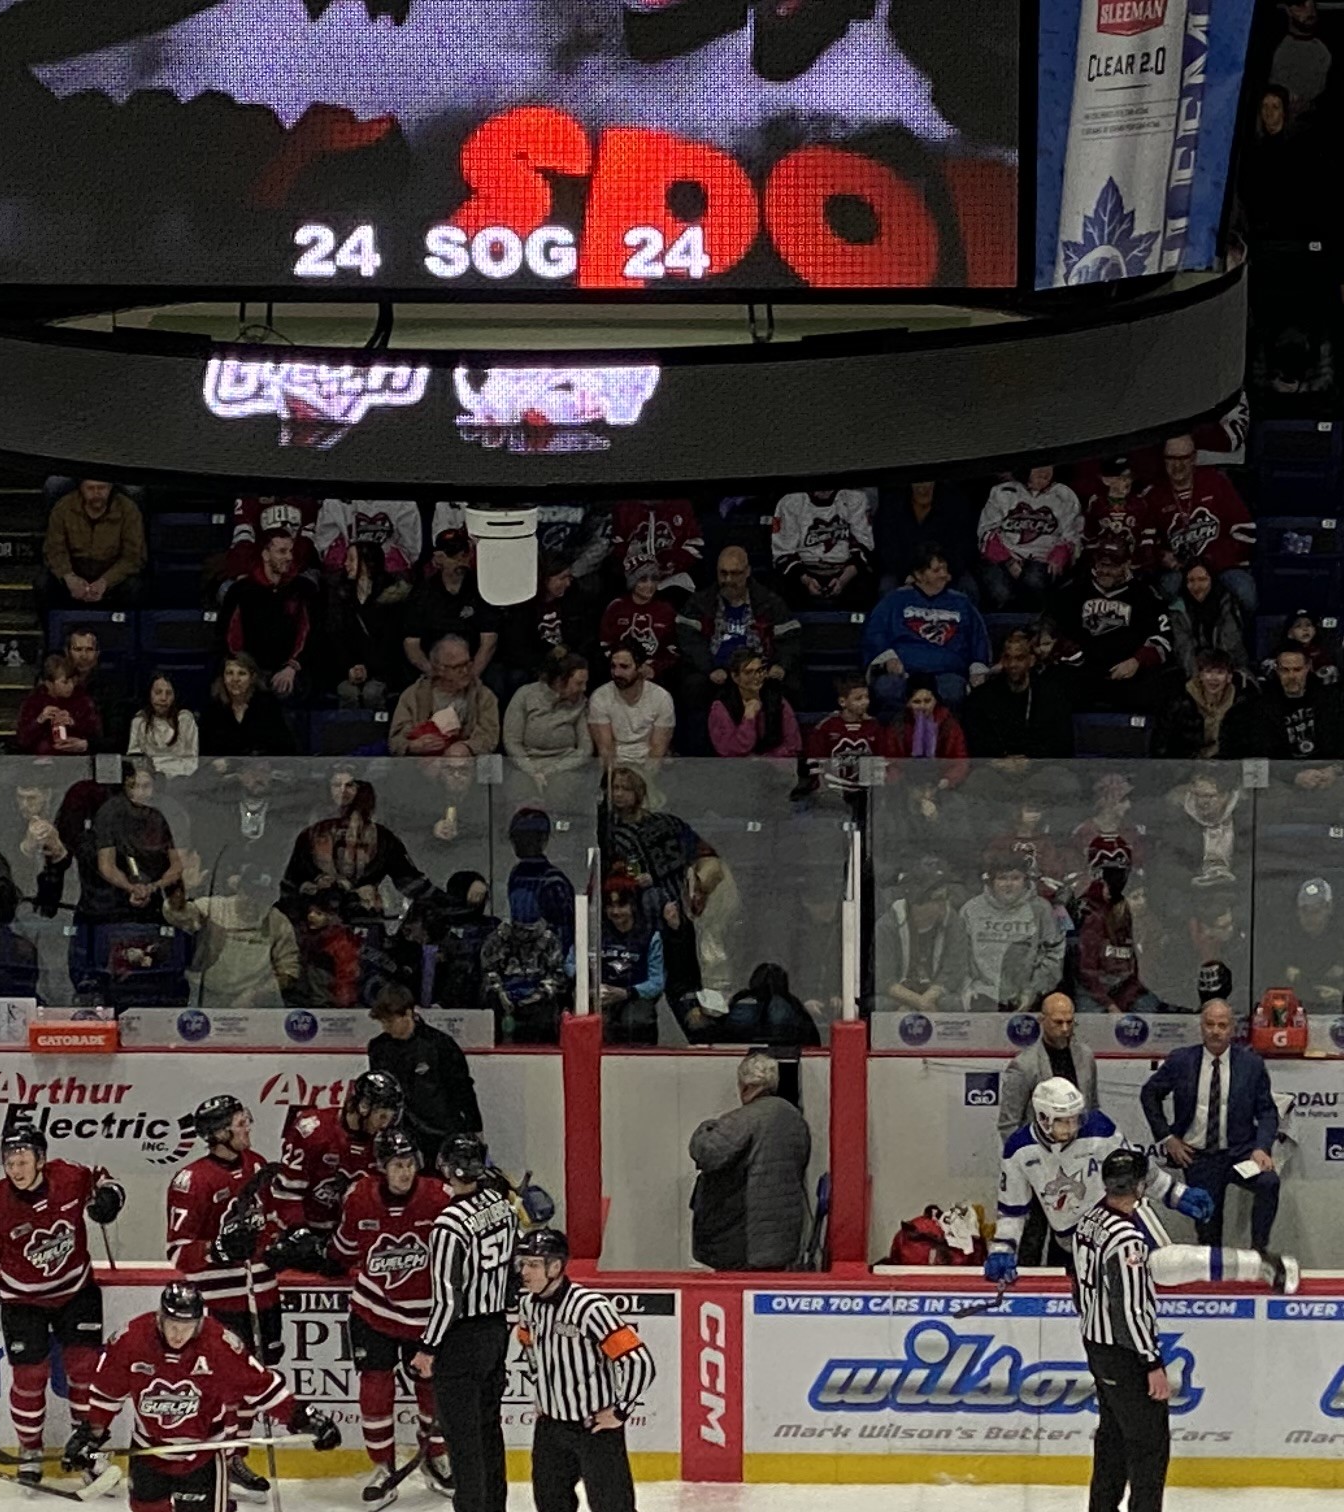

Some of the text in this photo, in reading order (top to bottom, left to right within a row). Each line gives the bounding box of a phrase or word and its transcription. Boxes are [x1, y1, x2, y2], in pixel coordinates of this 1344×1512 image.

[1087, 47, 1166, 81] CLEAR 2.0
[293, 224, 712, 279] 24 SOG 24
[37, 1034, 106, 1047] GATORADE
[1272, 1031, 1288, 1047] G
[1, 1102, 172, 1139] Electric
[141, 1142, 170, 1153] INC.
[282, 1143, 305, 1171] 22
[480, 1228, 509, 1270] 57
[369, 1252, 428, 1273] GUELPH
[300, 1293, 340, 1311] JIM
[770, 1297, 1013, 1314] OVER 700 CARS IN STCK
[1284, 1302, 1338, 1319] OVER
[190, 1355, 212, 1376] A
[699, 1300, 727, 1448] CCM
[139, 1389, 201, 1412] GUELPH
[773, 1424, 849, 1441] Mark
[858, 1423, 975, 1441] Wilson's
[983, 1424, 1081, 1441] Better
